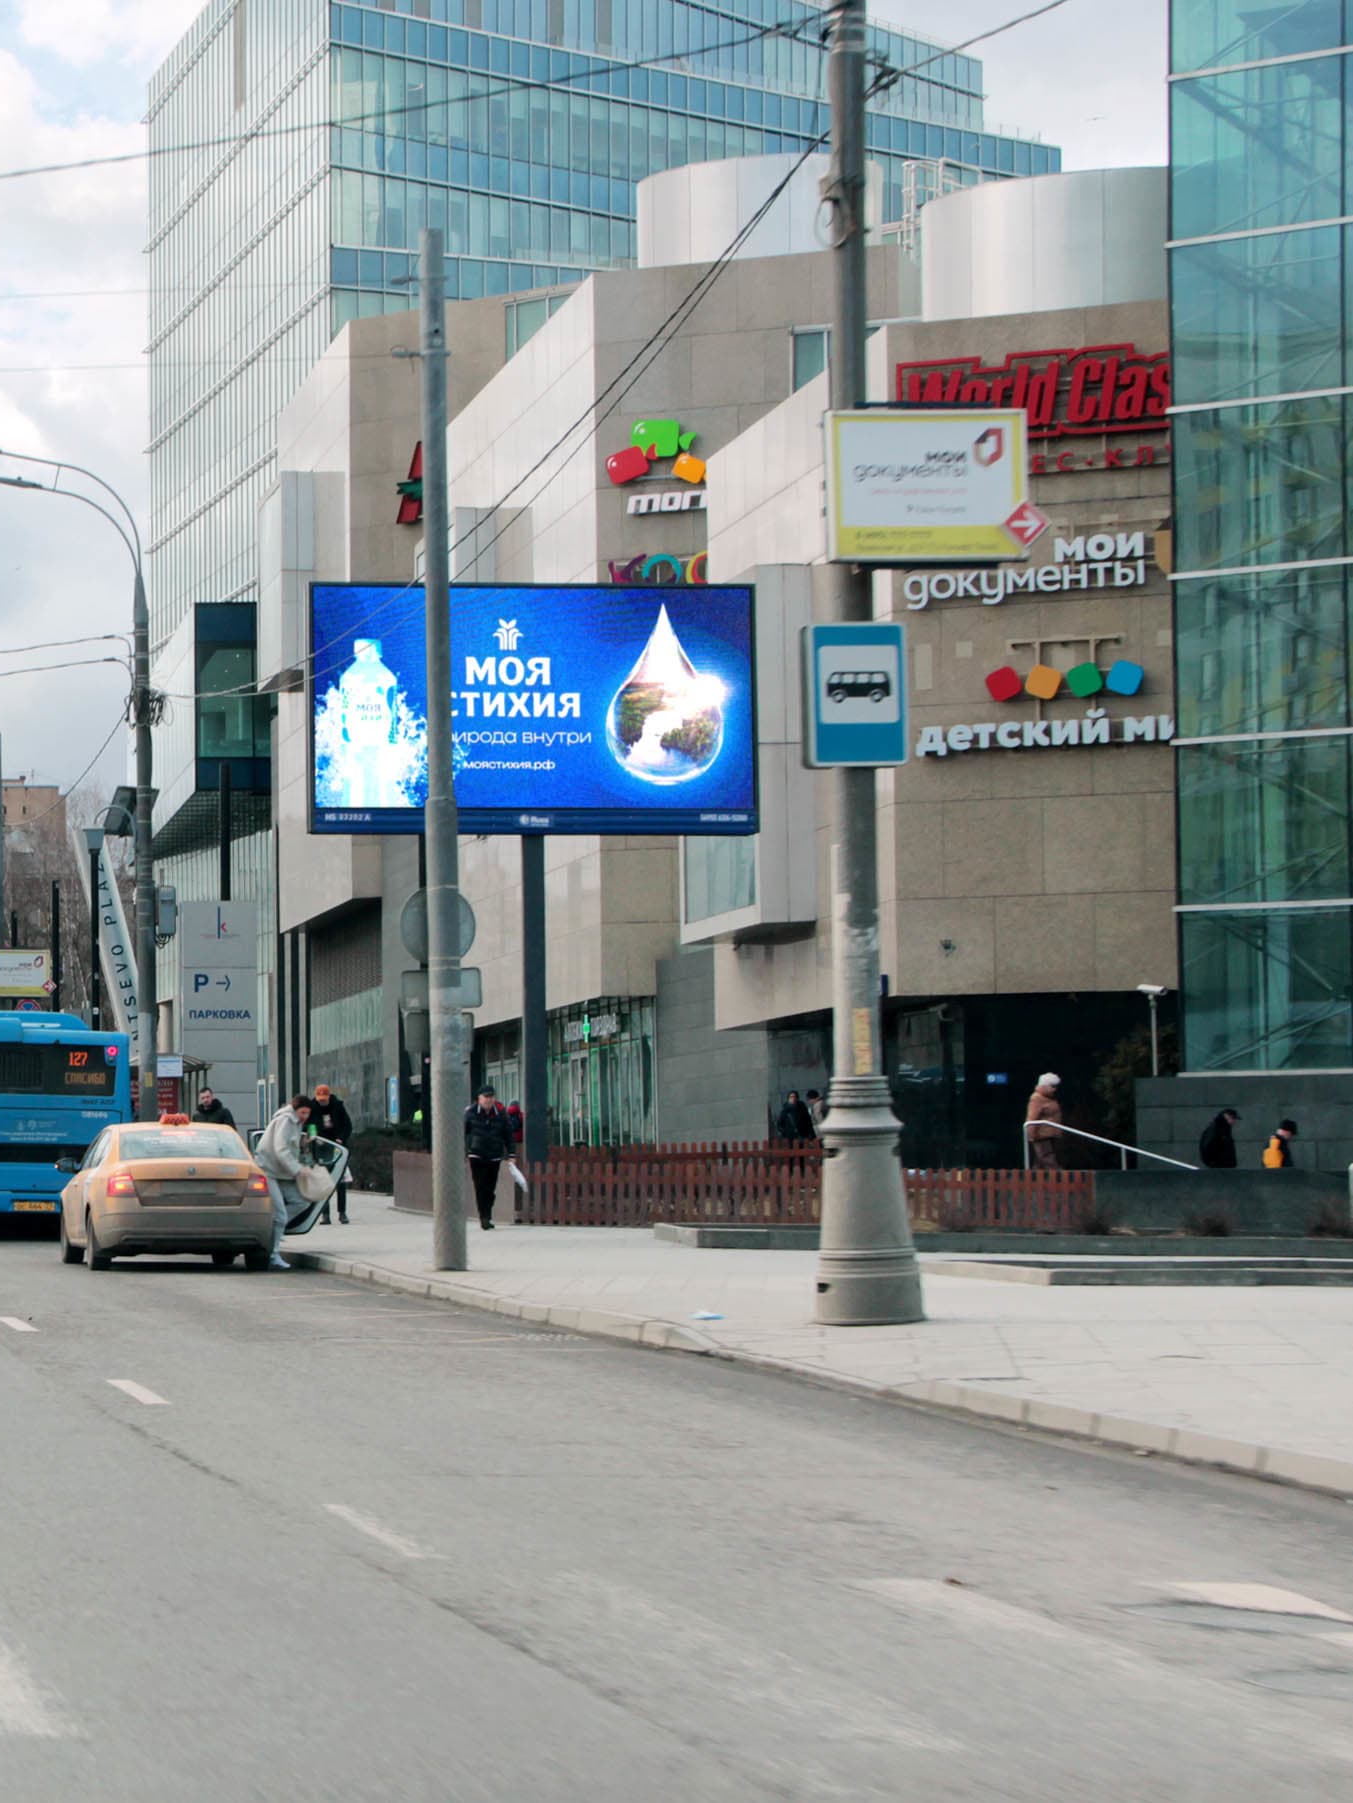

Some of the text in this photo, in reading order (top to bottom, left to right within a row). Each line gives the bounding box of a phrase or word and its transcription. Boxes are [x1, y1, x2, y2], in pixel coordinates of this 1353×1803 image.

[1054, 531, 1146, 563] мои
[903, 559, 1146, 611] документы
[465, 656, 551, 686] МОЯ
[451, 731, 593, 747] ирода внутри
[916, 707, 1110, 757] детский
[463, 759, 556, 771] моястихия.рф
[189, 1009, 251, 1019] ПАРКОВКА
[69, 1051, 88, 1066] 127
[64, 1072, 106, 1085] СПАСИБО
